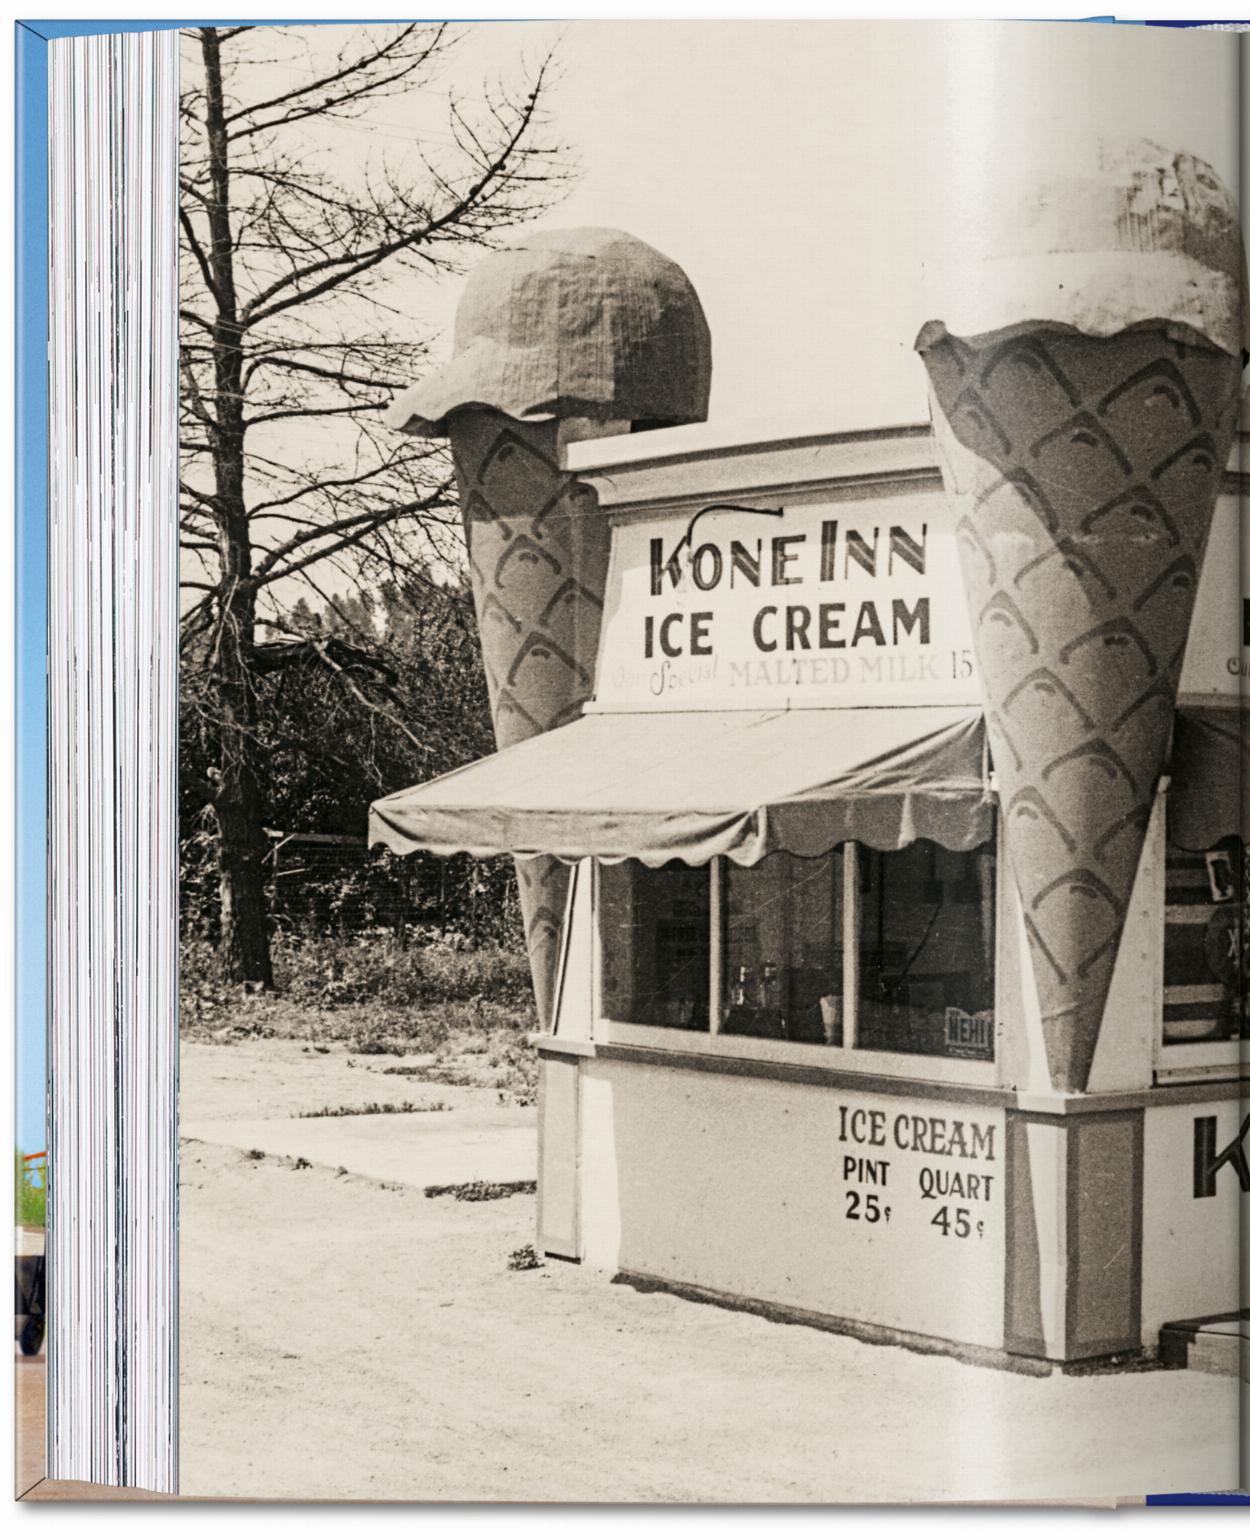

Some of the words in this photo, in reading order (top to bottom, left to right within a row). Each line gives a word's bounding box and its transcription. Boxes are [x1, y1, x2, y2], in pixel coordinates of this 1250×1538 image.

[650, 534, 806, 596] KONE
[820, 520, 927, 582] INN
[644, 612, 714, 658] ICE
[753, 598, 931, 652] CREAM
[729, 656, 850, 688] MALTED
[859, 653, 940, 685] MILK
[838, 1105, 886, 1146] ICE
[893, 1114, 996, 1161] CREAM
[843, 1155, 890, 1187] PINT
[919, 1167, 994, 1202] QUART
